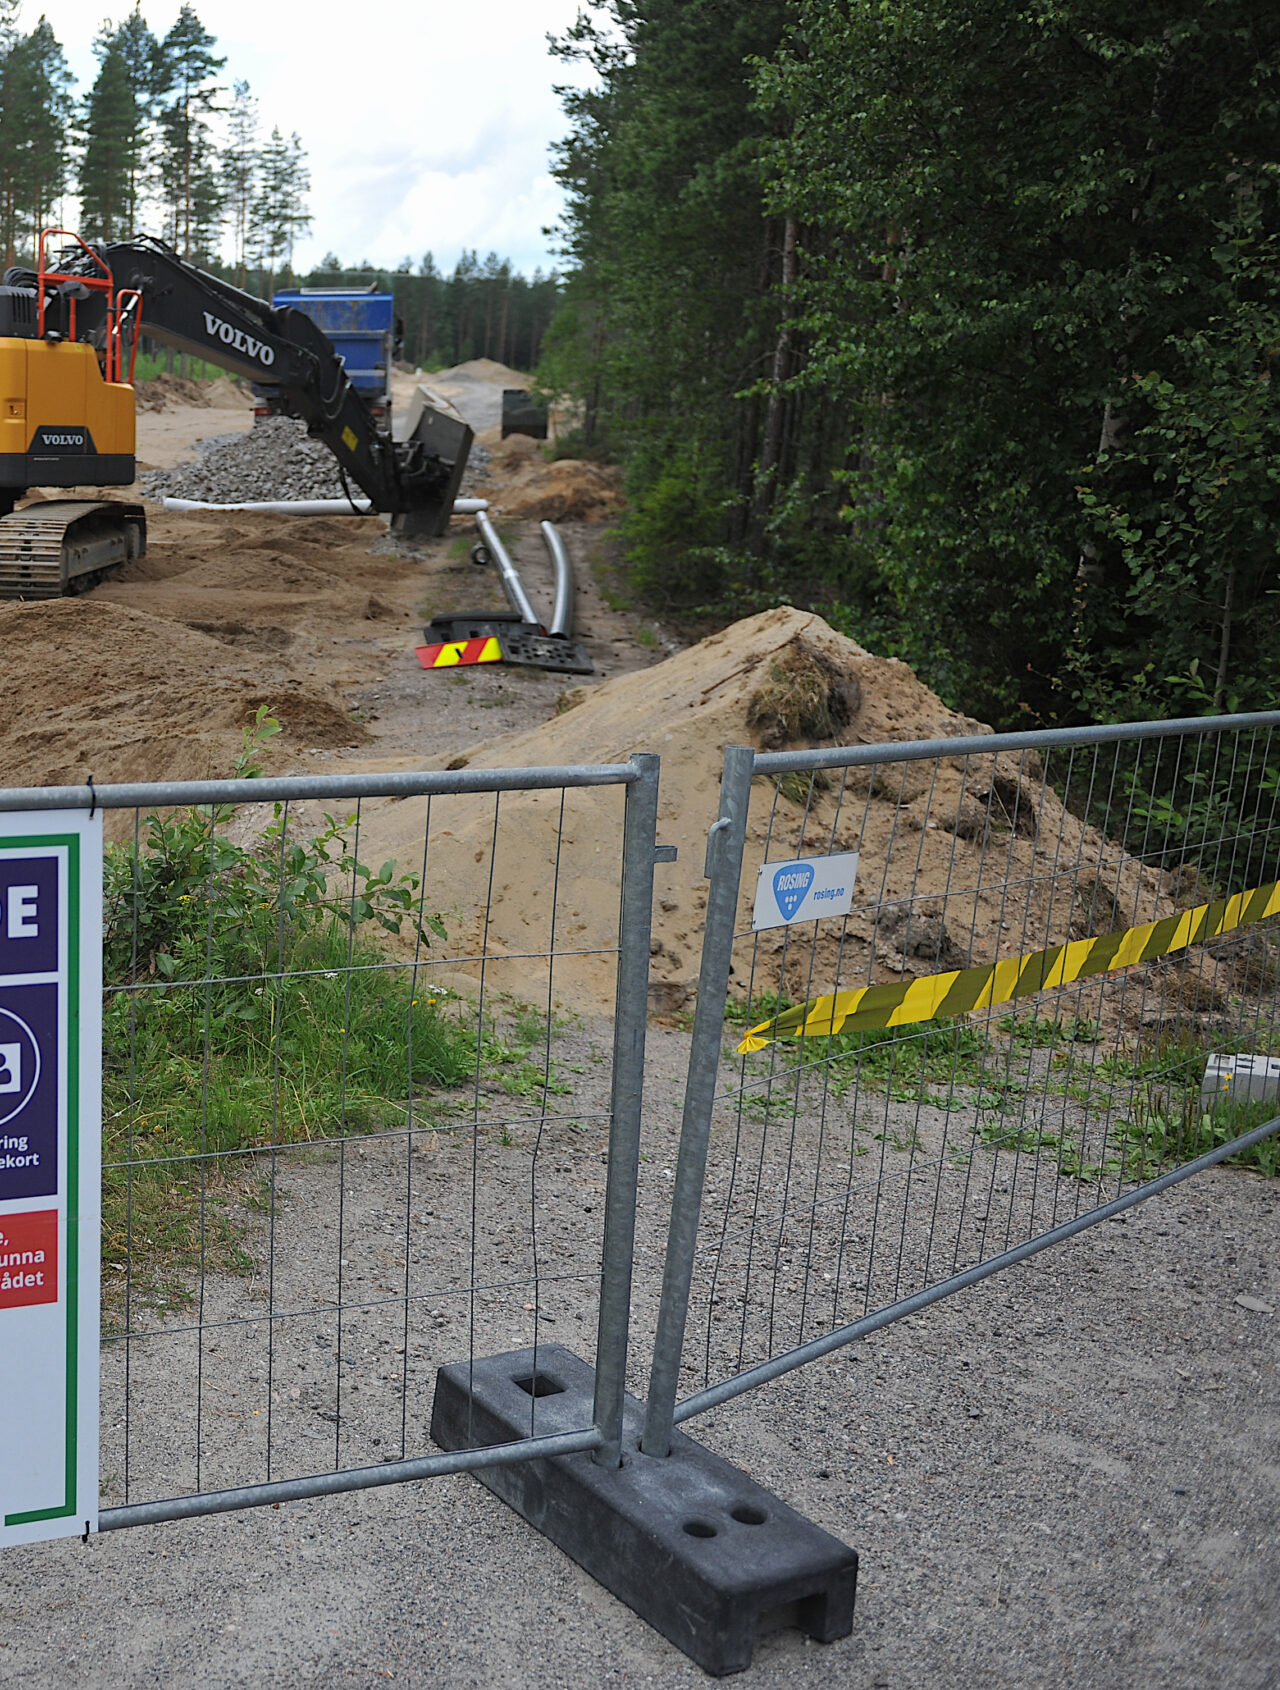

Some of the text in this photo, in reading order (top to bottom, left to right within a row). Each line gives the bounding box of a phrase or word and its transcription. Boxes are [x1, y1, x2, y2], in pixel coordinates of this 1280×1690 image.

[203, 311, 275, 366] VOLVO
[42, 434, 84, 445] VOLVO
[777, 871, 810, 891] ROSING
[813, 887, 845, 901] rosing.no
